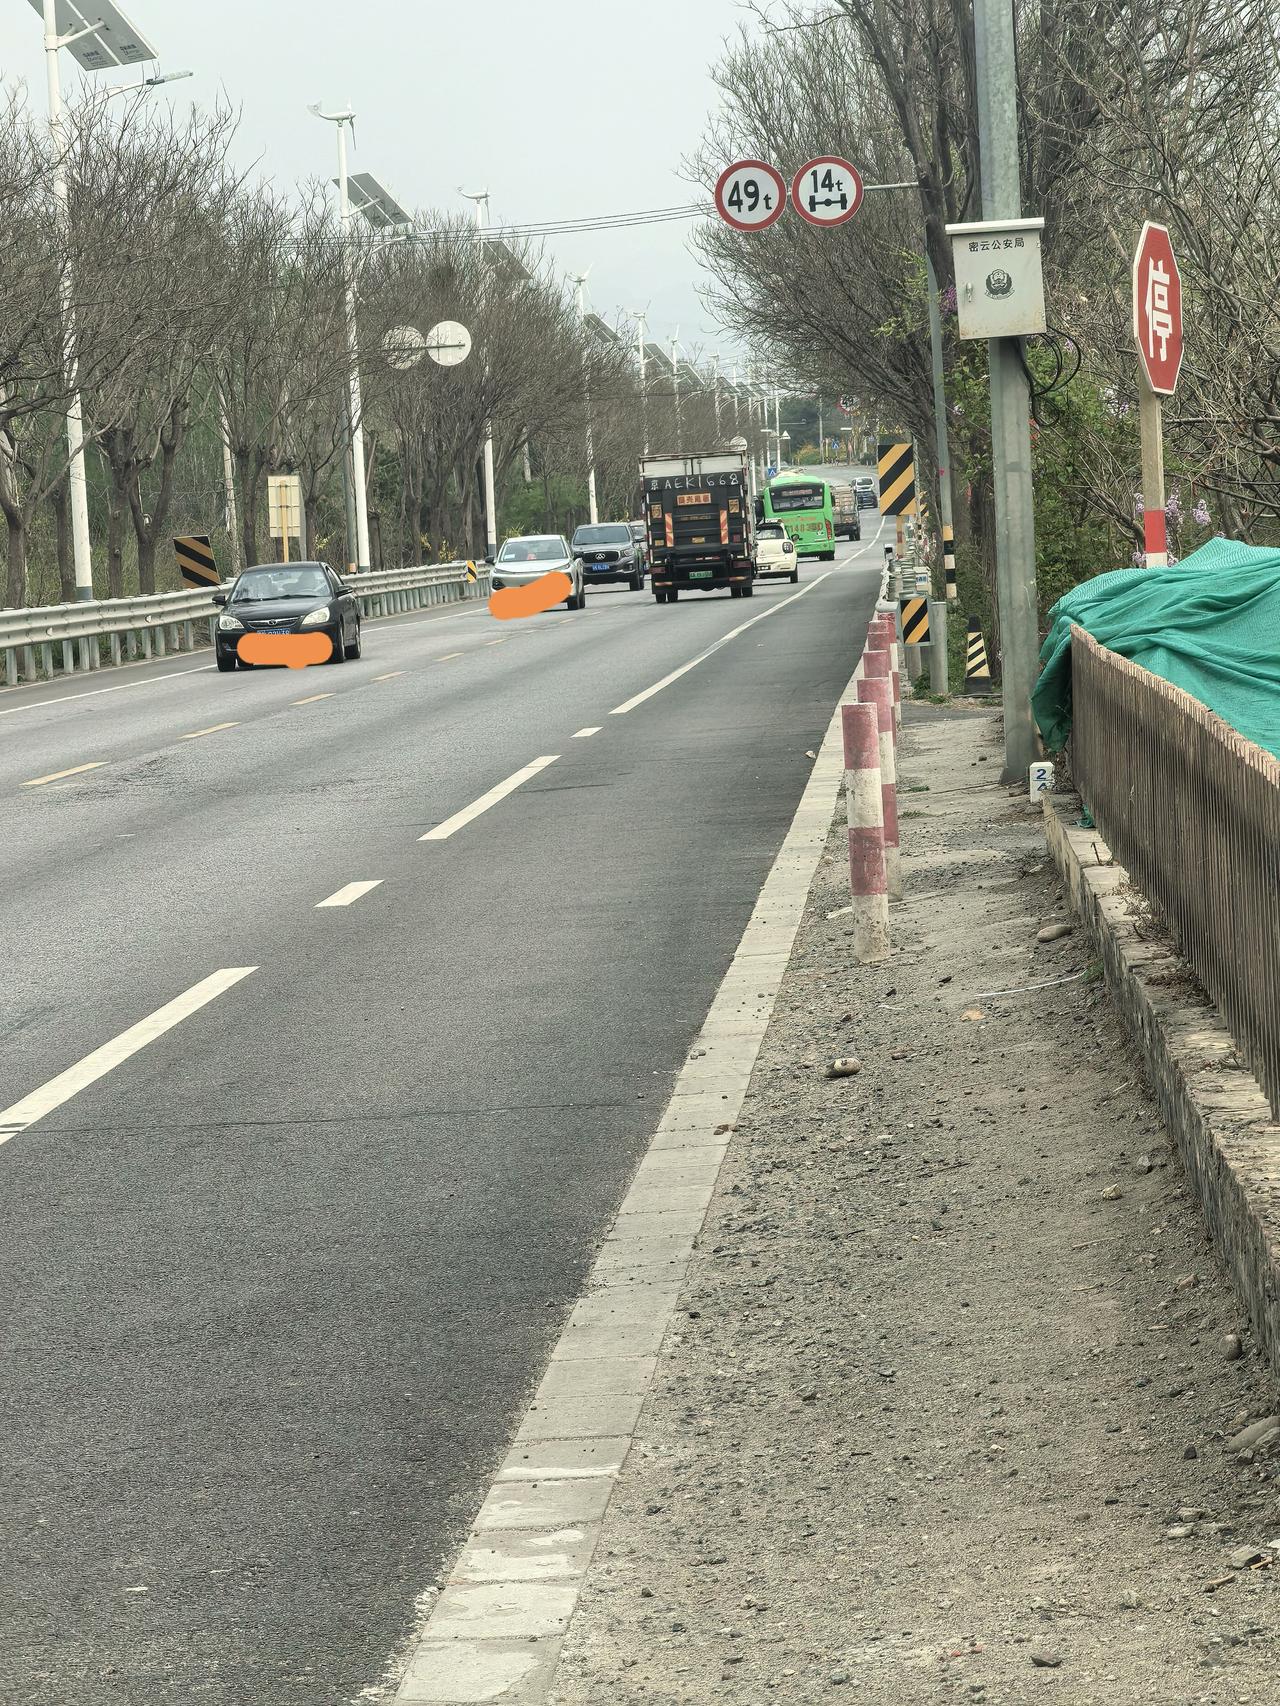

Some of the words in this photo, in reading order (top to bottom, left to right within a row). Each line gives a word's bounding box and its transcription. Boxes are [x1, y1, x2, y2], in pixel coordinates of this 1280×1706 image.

[810, 168, 844, 194] 14t
[727, 179, 773, 213] 49t
[968, 237, 1025, 252] 密云公安局
[1145, 256, 1173, 362] 停
[1036, 768, 1047, 780] 2
